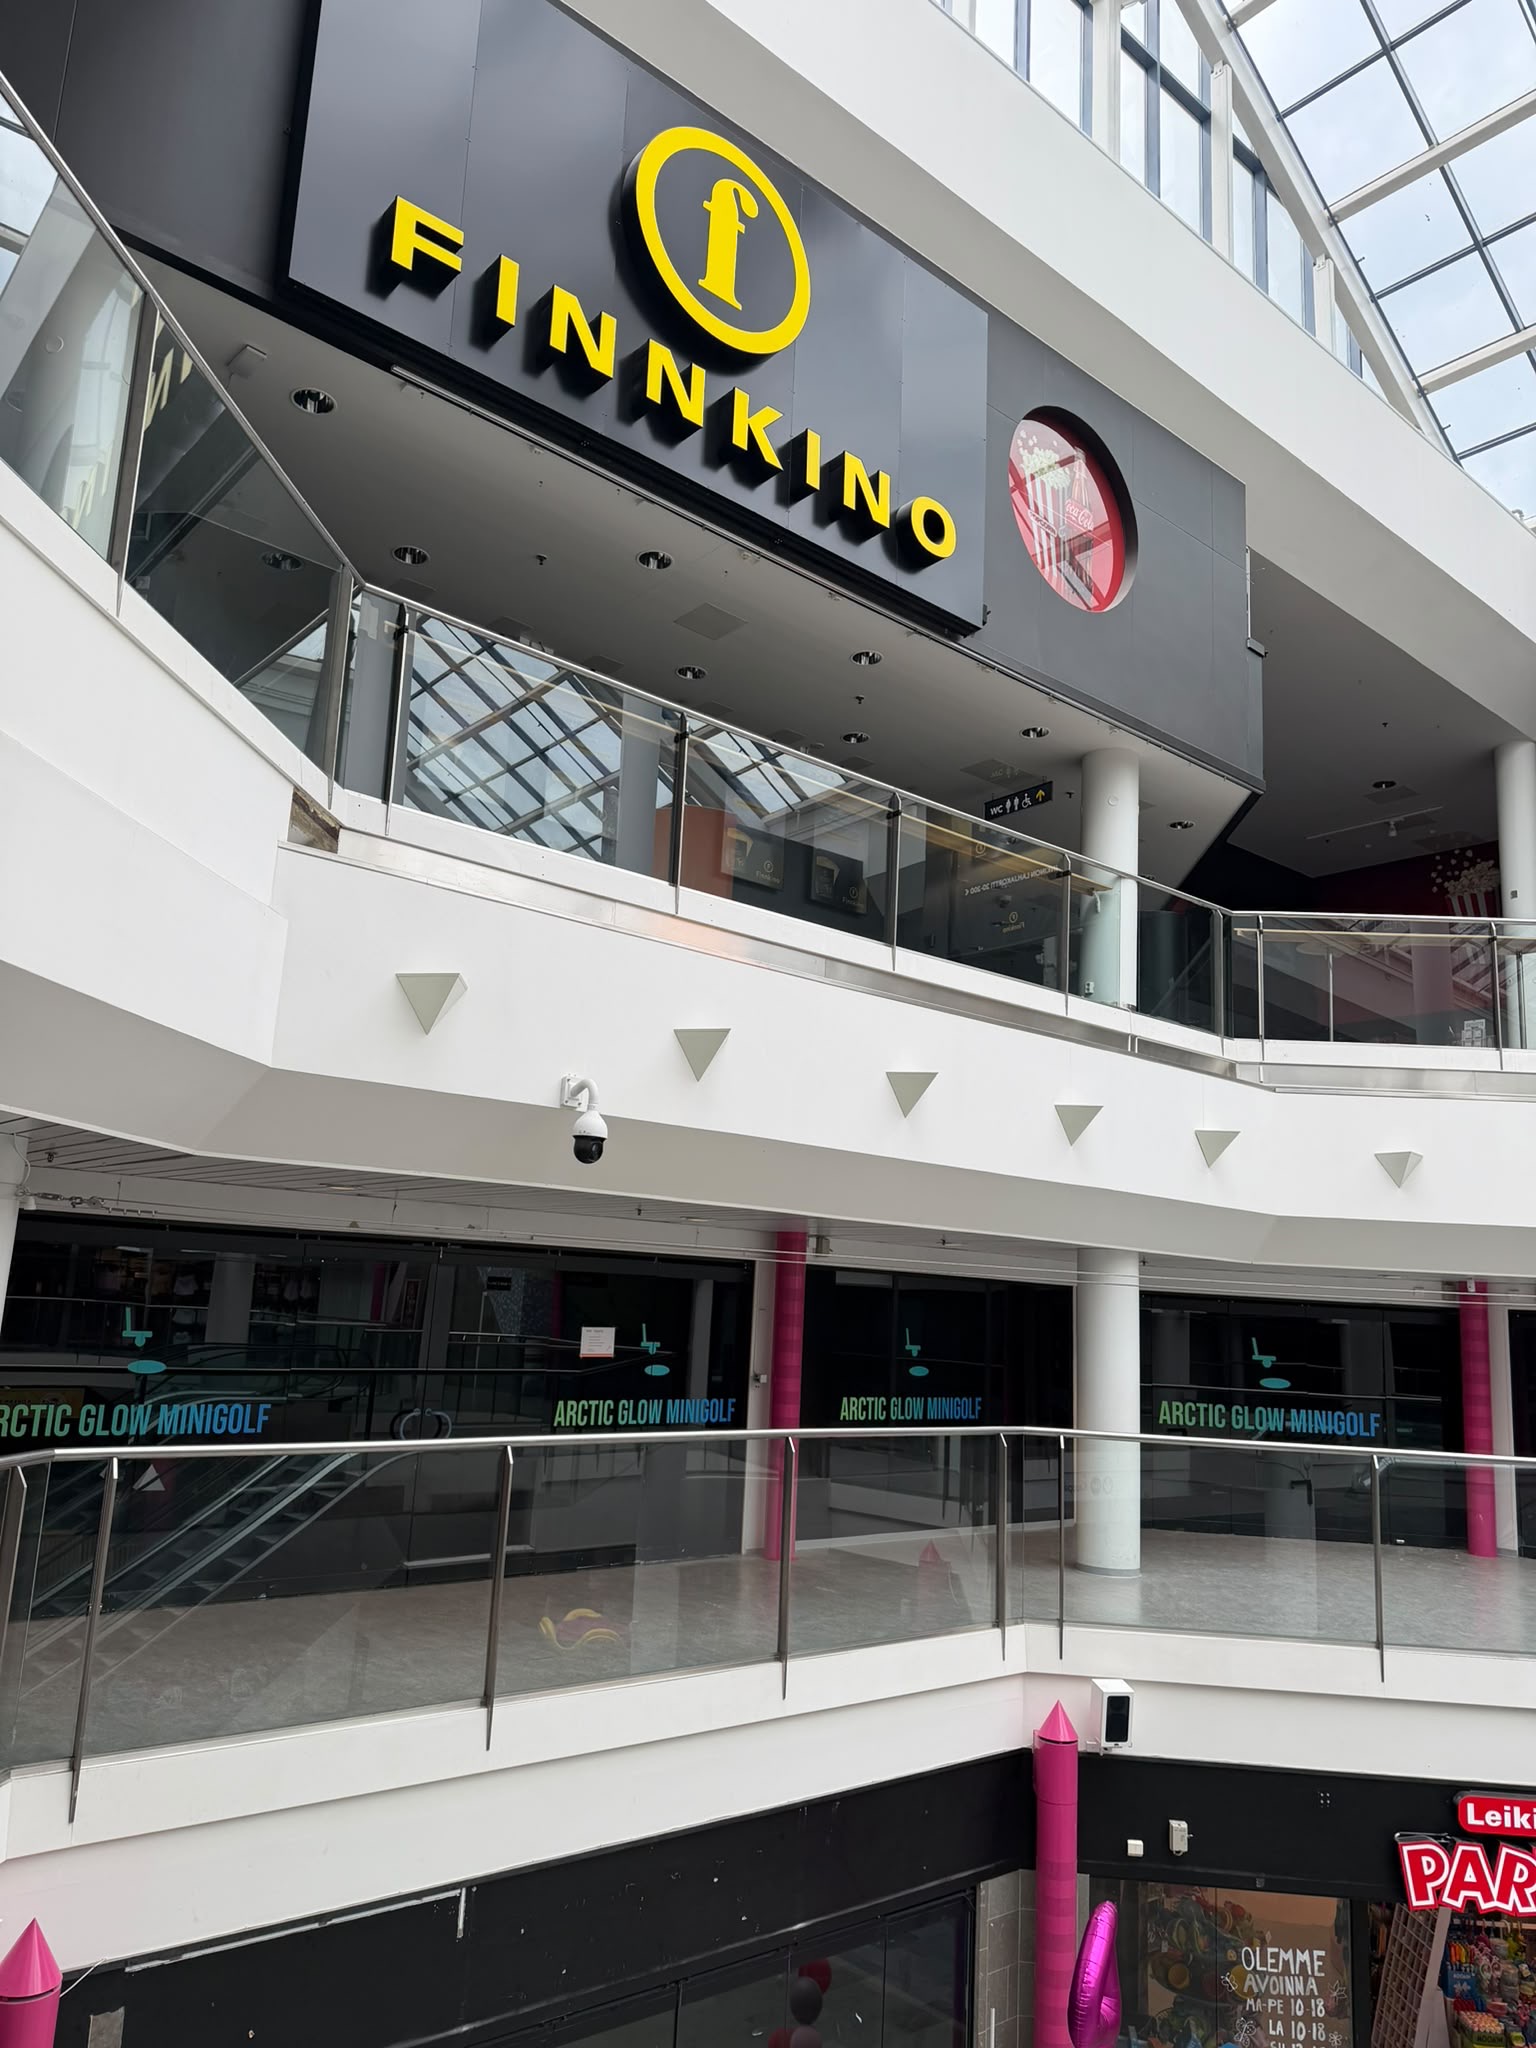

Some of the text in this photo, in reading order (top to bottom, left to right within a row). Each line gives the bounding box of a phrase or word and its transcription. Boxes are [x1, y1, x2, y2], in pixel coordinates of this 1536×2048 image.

[391, 194, 958, 559] FINNKINO
[990, 805, 1004, 815] WC
[0, 1403, 272, 1437] RCTIC GLOW MINIGOLF
[553, 1398, 736, 1427] ARCTIC GLOW MINIGOLF
[840, 1396, 982, 1422] ARCTIC GLOW MINIGOLF
[1158, 1400, 1382, 1438] ARCTIC GLOW MINIGOLF
[1399, 1840, 1536, 1918] PAR
[1241, 1946, 1326, 1977] OLEMME
[1243, 1973, 1319, 1997] AVOINNA
[1246, 1998, 1284, 2015] MA-PE
[1269, 2019, 1285, 2037] LA
